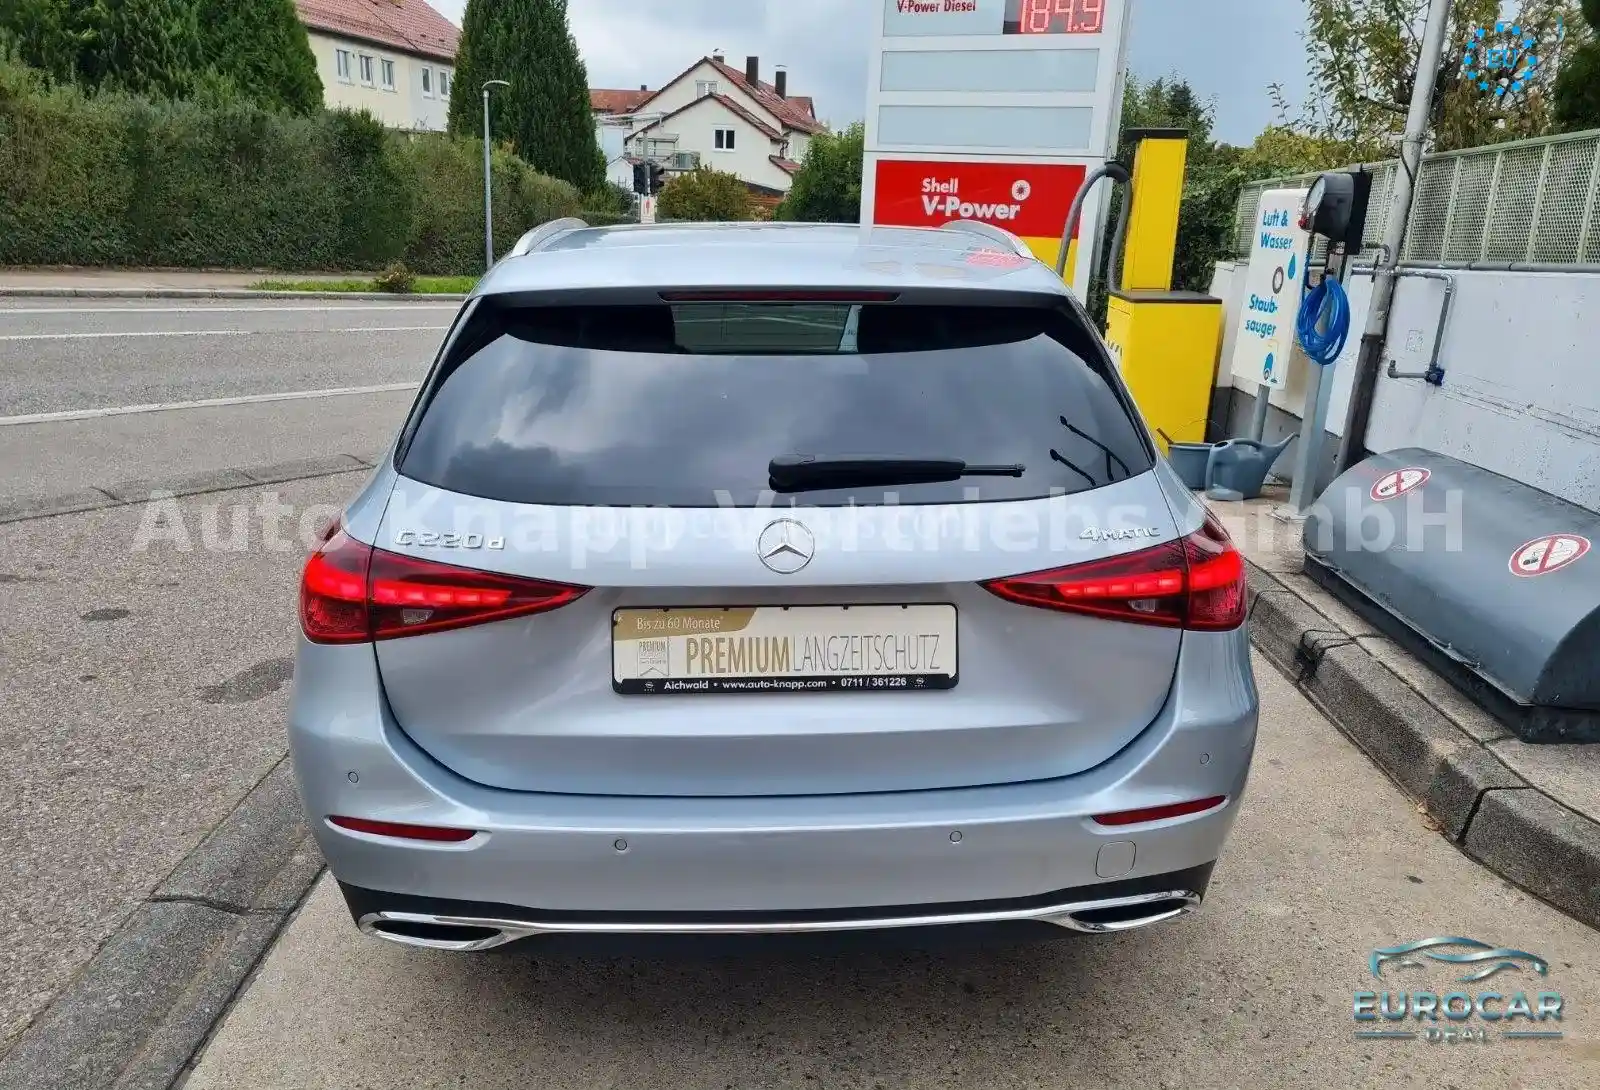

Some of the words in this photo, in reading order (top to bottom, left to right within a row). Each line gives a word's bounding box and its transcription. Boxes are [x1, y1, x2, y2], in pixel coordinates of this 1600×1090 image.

[897, 0, 939, 12] V-Power
[944, 0, 976, 11] Diesel
[921, 177, 959, 193] Shell
[921, 195, 1020, 220] V-Power
[1262, 209, 1280, 226] Luft
[1281, 210, 1289, 227] &
[1260, 232, 1293, 249] Wasser
[1248, 293, 1278, 314] Staub-
[1245, 319, 1277, 339] sauger
[1078, 524, 1161, 541] 4MATIC
[637, 618, 651, 630] Bis
[653, 620, 665, 629] zu
[668, 618, 680, 629] 60
[664, 681, 709, 690] Aichwald
[722, 680, 827, 690] www.auto-knapp.com
[840, 678, 863, 687] 0711
[872, 677, 907, 687] 361226
